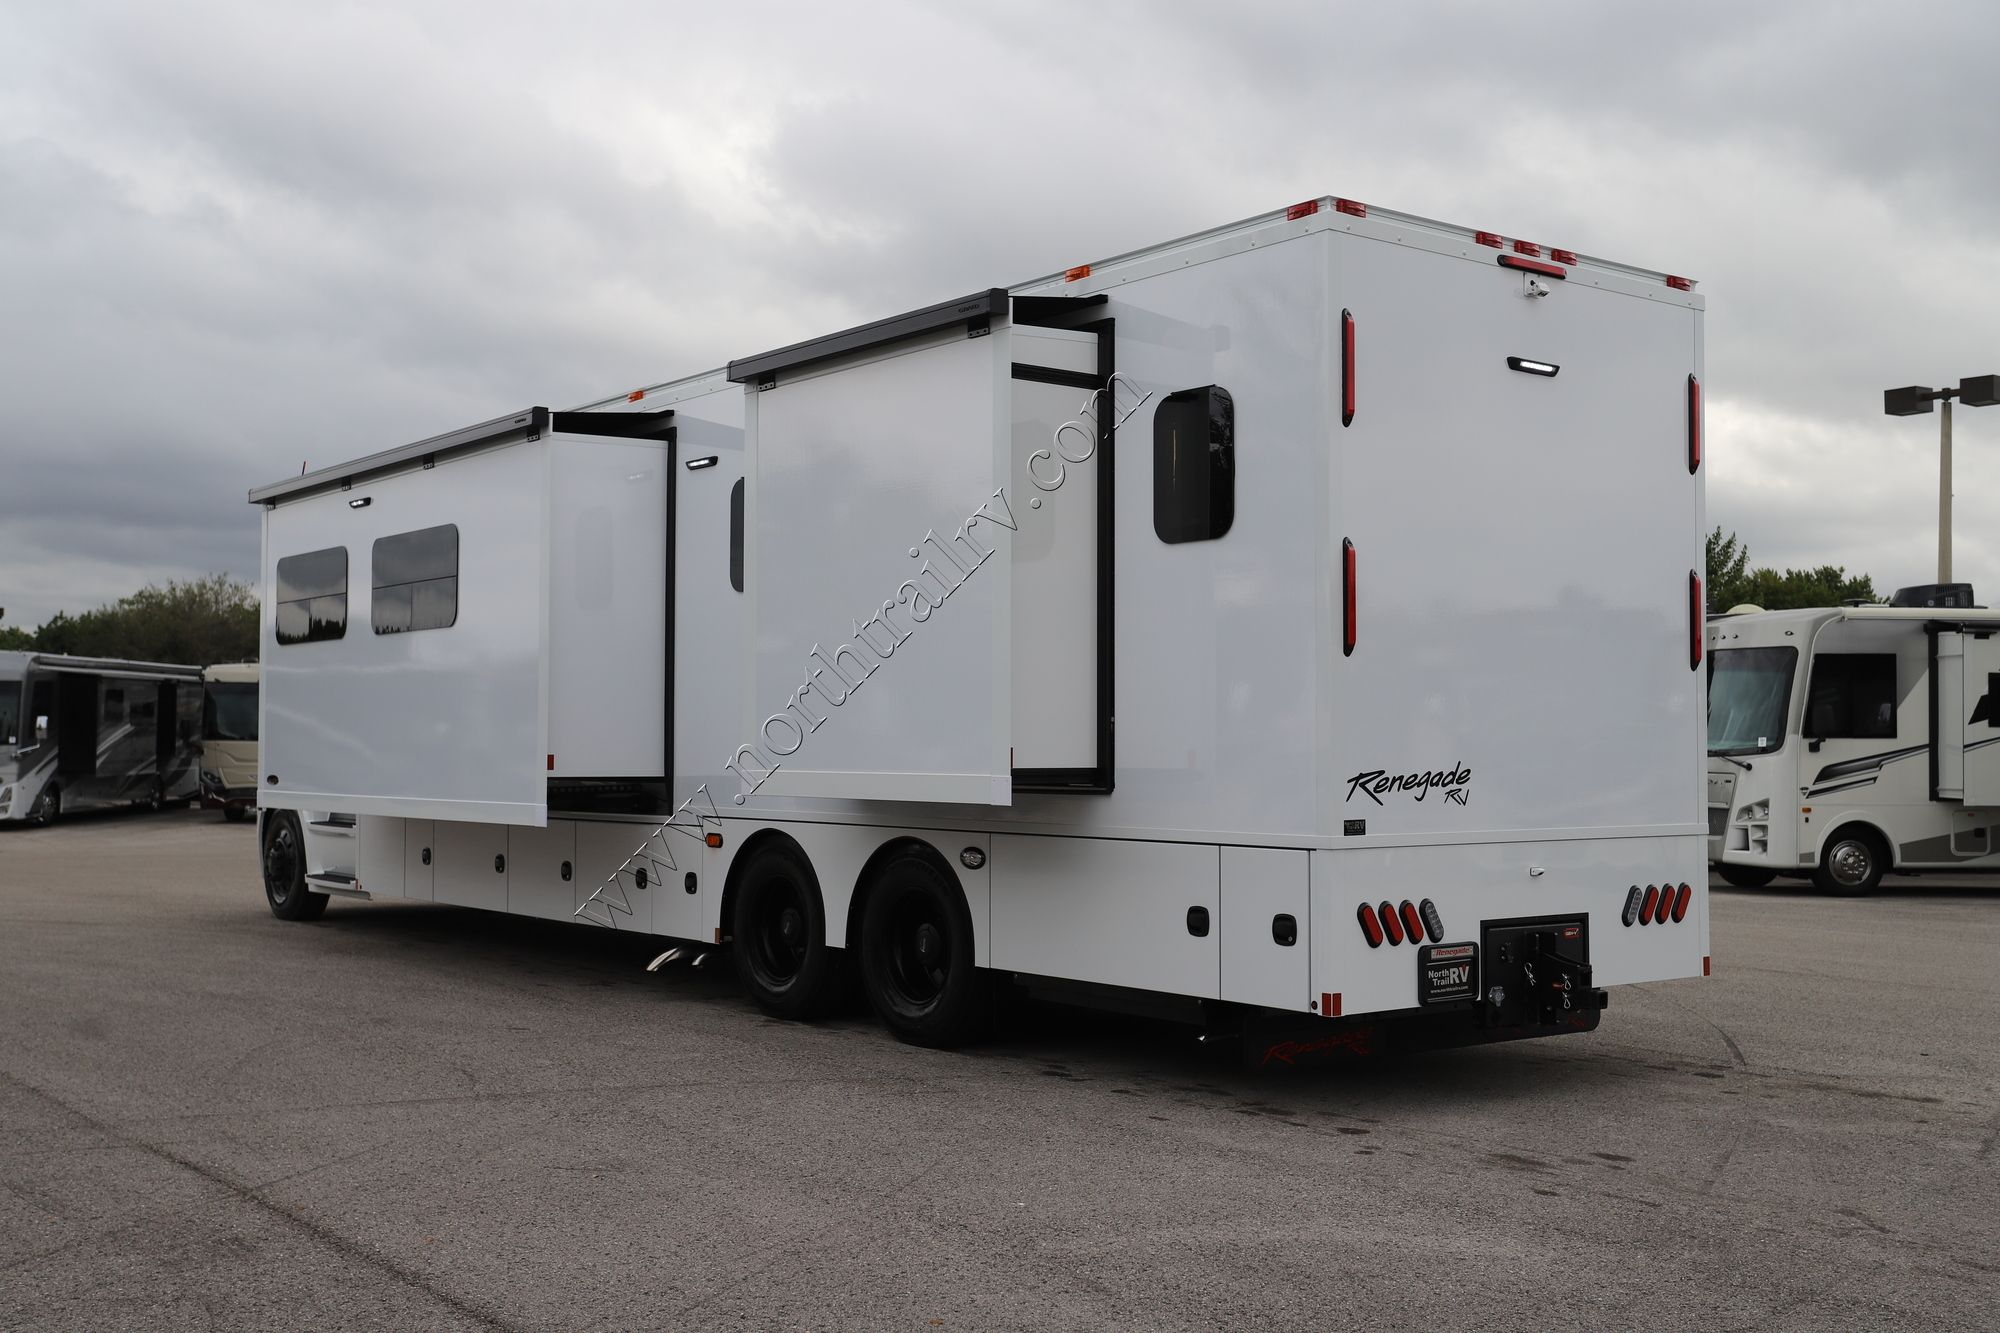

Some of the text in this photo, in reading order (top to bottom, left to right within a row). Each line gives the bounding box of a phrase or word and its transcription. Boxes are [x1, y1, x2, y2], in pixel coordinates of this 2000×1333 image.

[1346, 761, 1471, 806] Renegade
[1444, 788, 1470, 806] RV
[1428, 969, 1450, 979] North
[1432, 977, 1450, 986] Trail
[1450, 966, 1470, 985] RV
